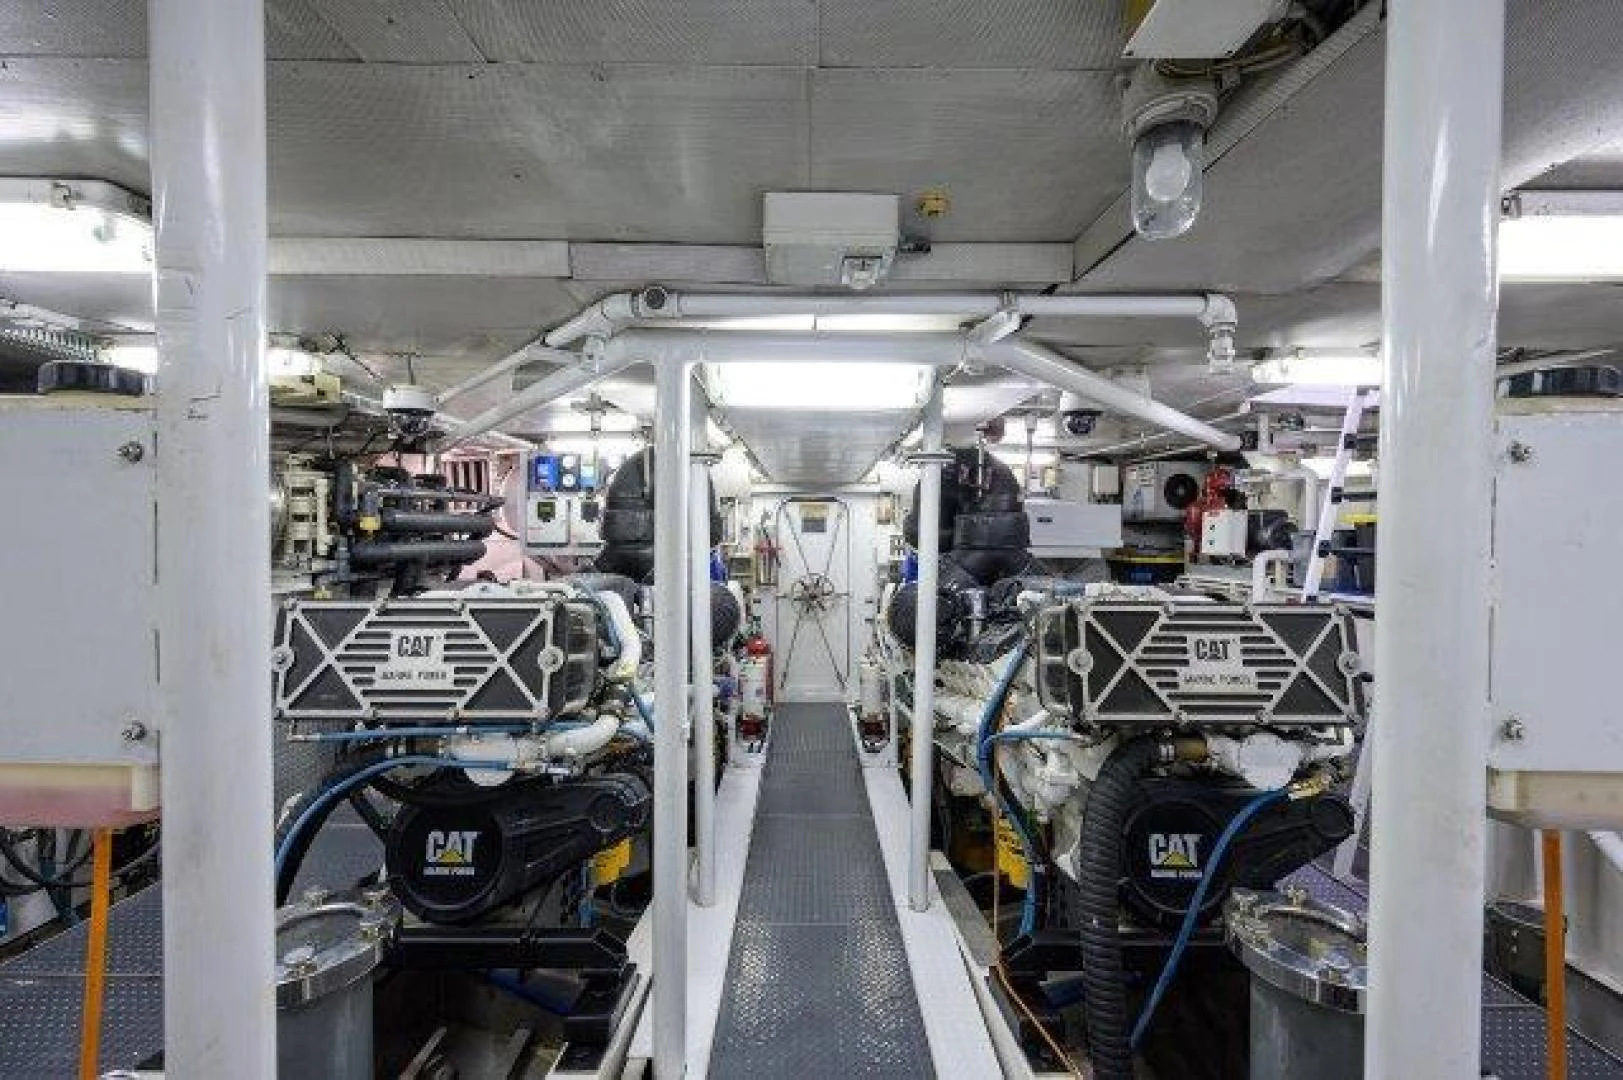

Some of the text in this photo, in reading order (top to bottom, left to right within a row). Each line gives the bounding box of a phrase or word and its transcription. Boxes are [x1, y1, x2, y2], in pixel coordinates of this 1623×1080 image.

[398, 635, 435, 657] CAT
[1194, 638, 1231, 662] CAT
[425, 830, 479, 863] CAT
[1148, 833, 1202, 868] CAT
